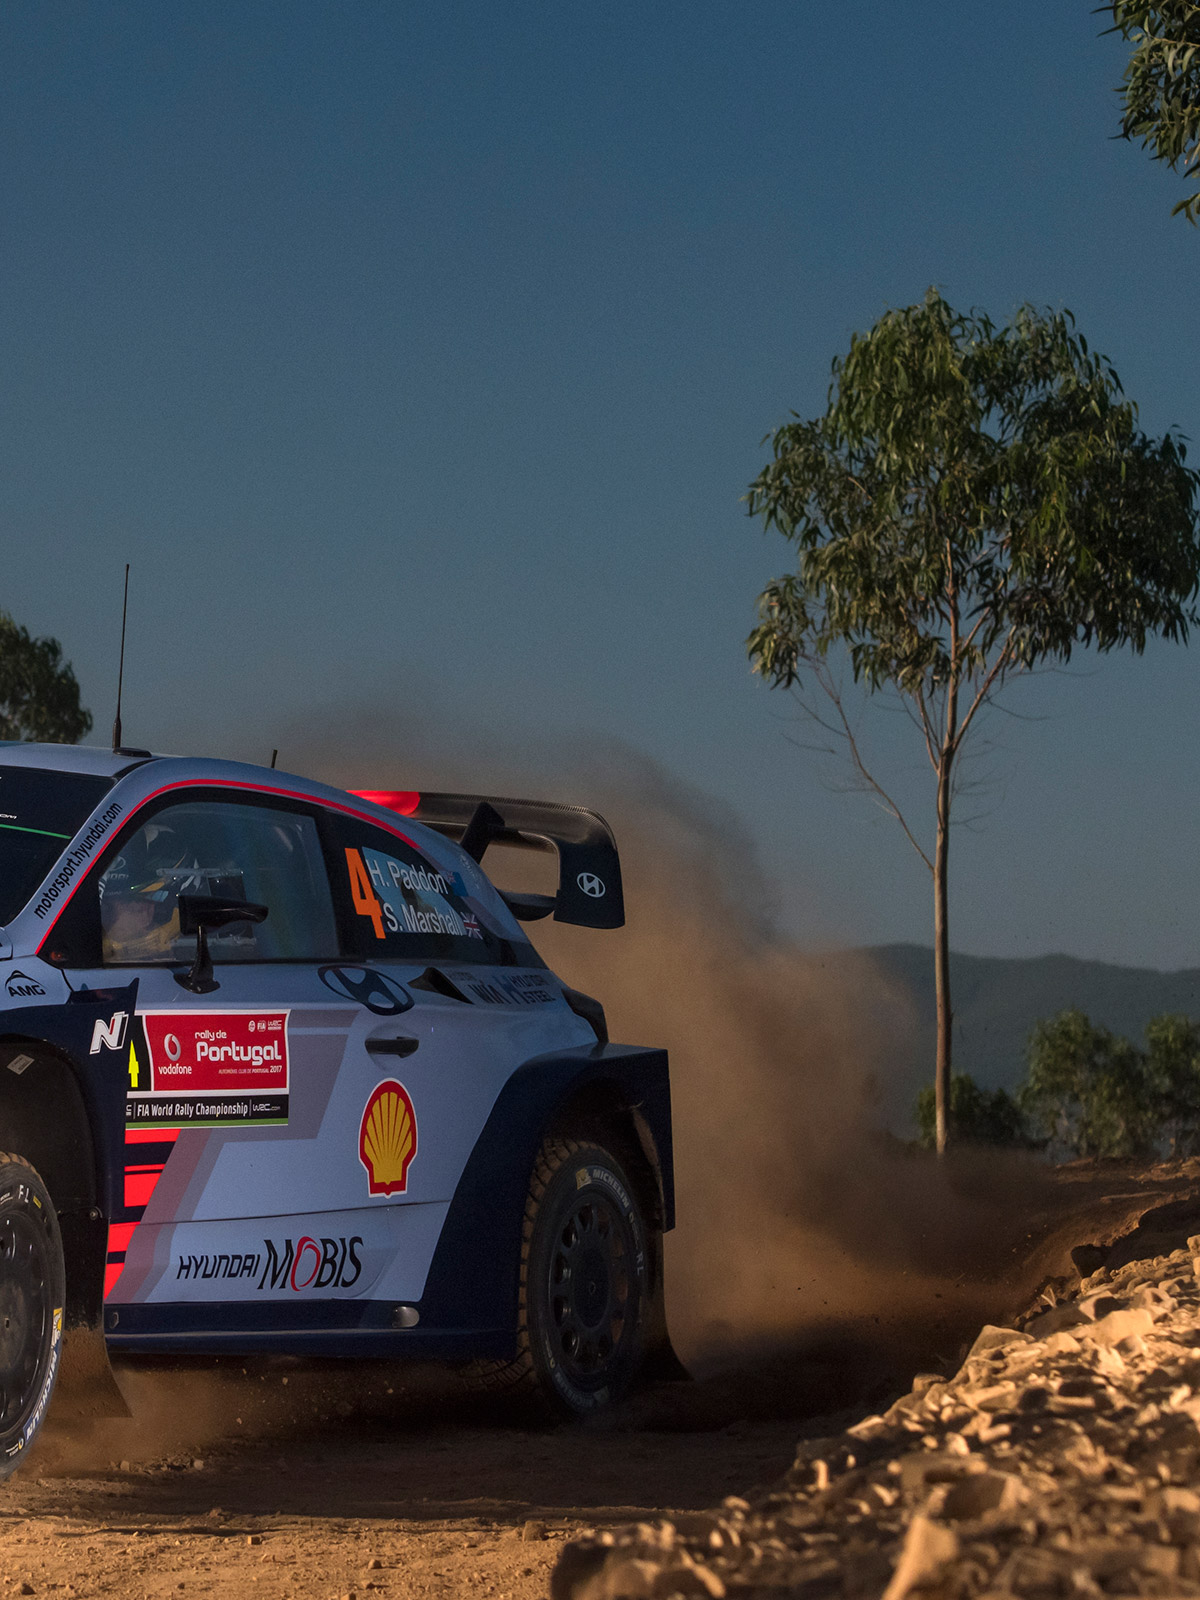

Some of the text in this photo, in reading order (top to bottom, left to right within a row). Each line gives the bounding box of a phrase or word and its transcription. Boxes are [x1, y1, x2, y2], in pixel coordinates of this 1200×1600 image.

[33, 802, 124, 920] motorsport.hyundai.com
[365, 858, 390, 888] H.
[390, 861, 449, 896] Paddon
[344, 847, 386, 939] 4
[385, 903, 464, 937] S. Marshall
[8, 984, 47, 998] AMG
[89, 1011, 129, 1055] N
[194, 1029, 228, 1042] rally de
[158, 1063, 193, 1076] vodafone
[196, 1040, 282, 1067] Portugal
[269, 1065, 283, 1074] 2017
[136, 1103, 150, 1117] FIA
[151, 1103, 173, 1117] World
[174, 1102, 194, 1118] Rally
[195, 1101, 249, 1117] Championship
[592, 1168, 630, 1209] MICHELIN
[176, 1235, 364, 1292] HYUNDAI MOBIS
